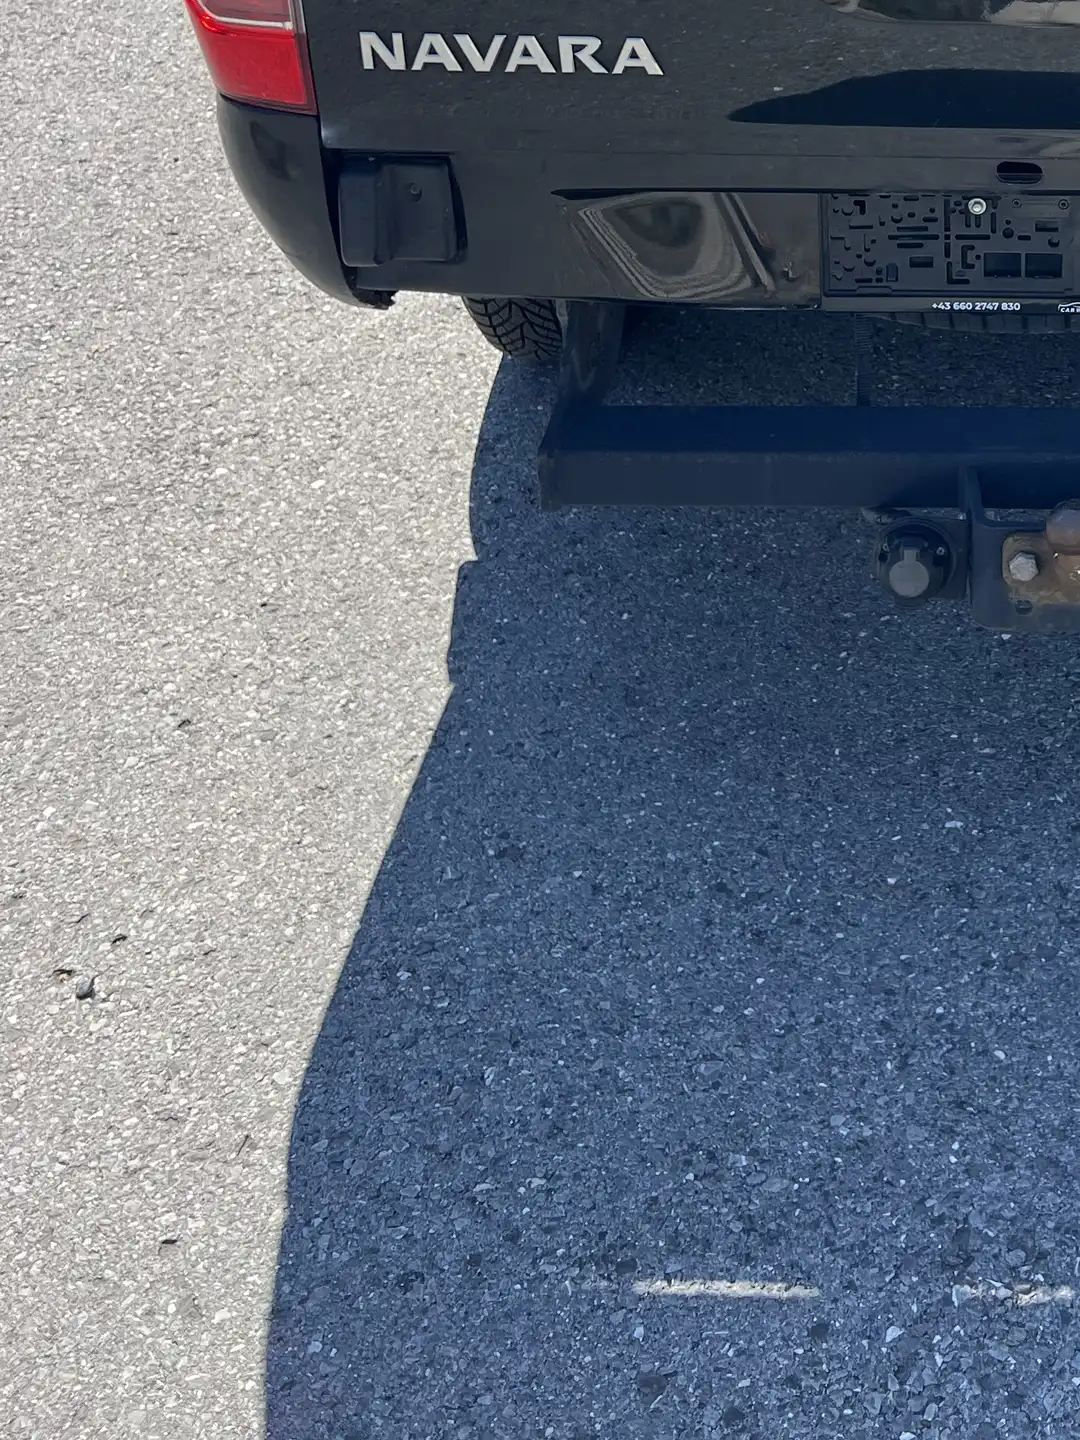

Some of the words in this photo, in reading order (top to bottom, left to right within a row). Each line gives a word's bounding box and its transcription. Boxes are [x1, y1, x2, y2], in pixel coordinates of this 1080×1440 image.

[359, 31, 664, 75] NAVARA
[932, 302, 951, 311] +43
[953, 302, 973, 311] 660
[974, 302, 999, 311] 2747
[1001, 302, 1021, 312] 830
